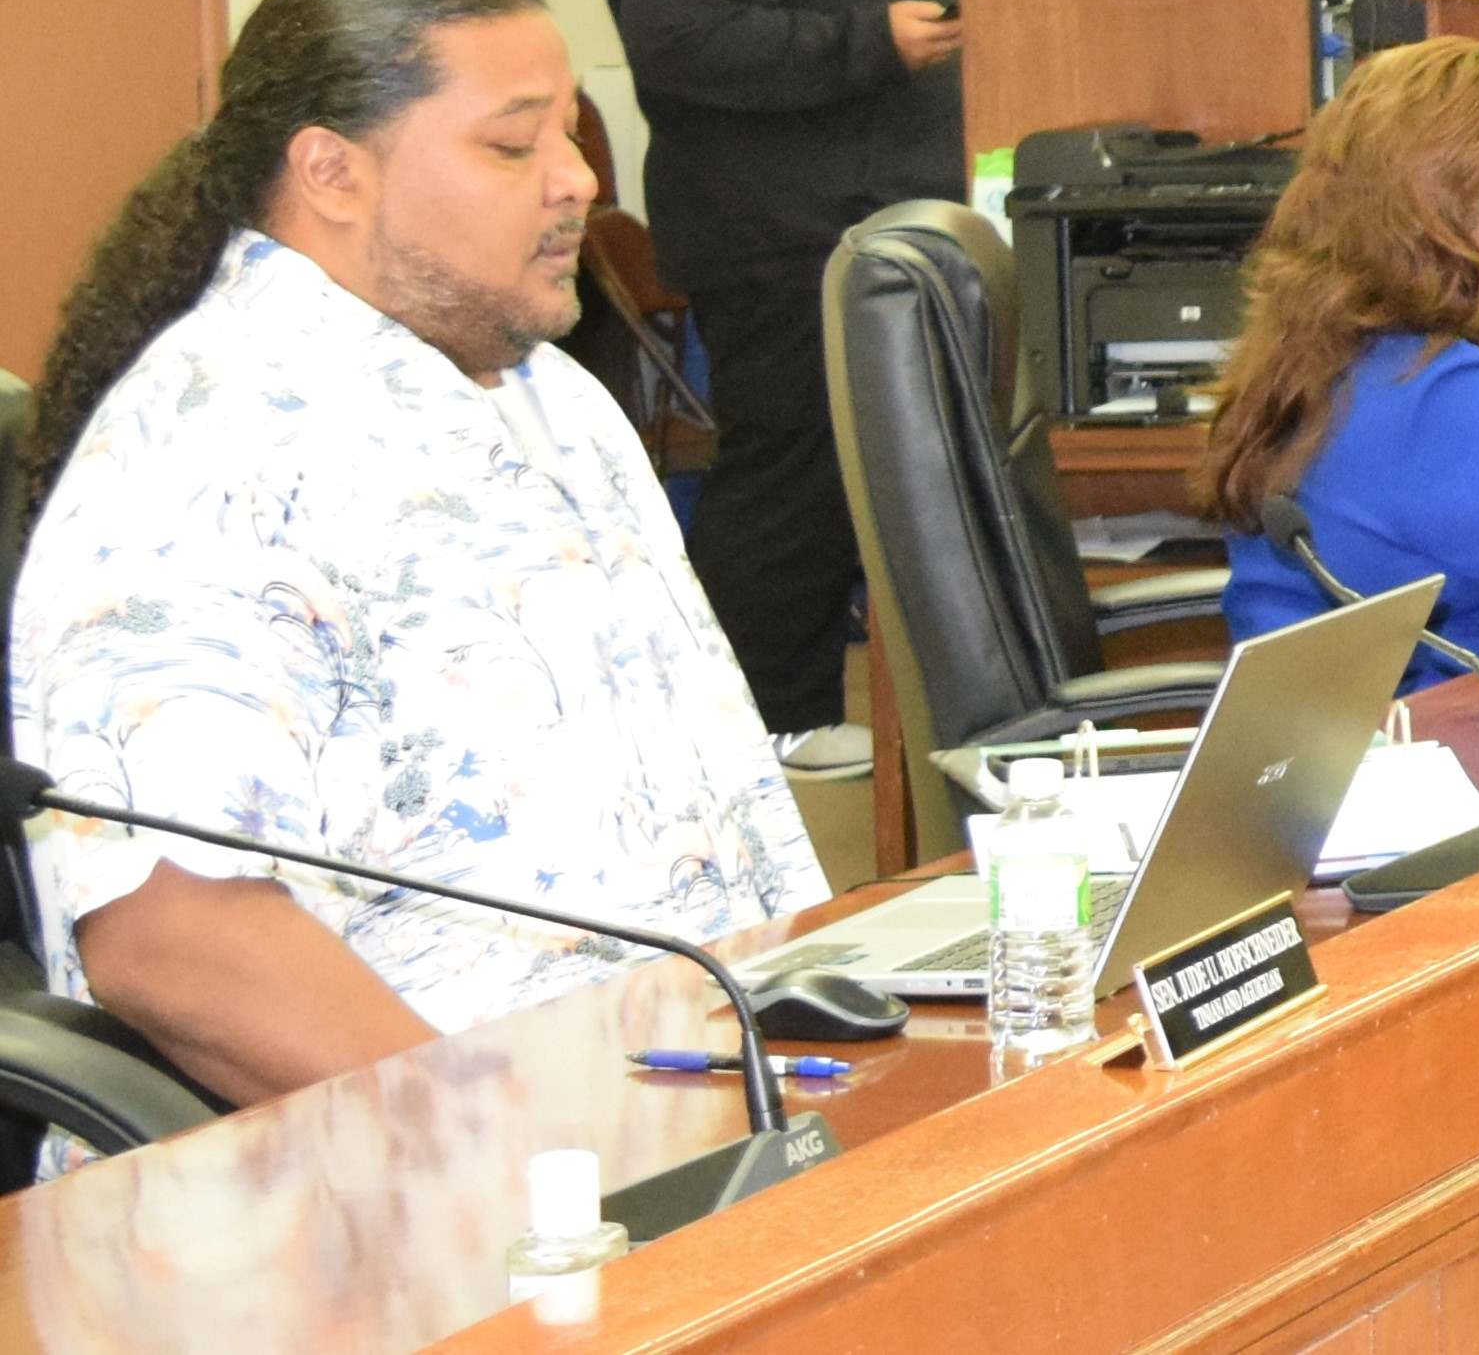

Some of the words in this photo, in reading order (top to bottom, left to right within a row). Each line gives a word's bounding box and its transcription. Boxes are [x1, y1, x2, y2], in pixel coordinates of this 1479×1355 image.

[1150, 974, 1183, 1014] SEN.
[1176, 961, 1210, 1001] JUDE
[1203, 954, 1223, 986] U.
[1215, 916, 1303, 981] HOFSCHNEIDER
[785, 1130, 825, 1167] AKG
